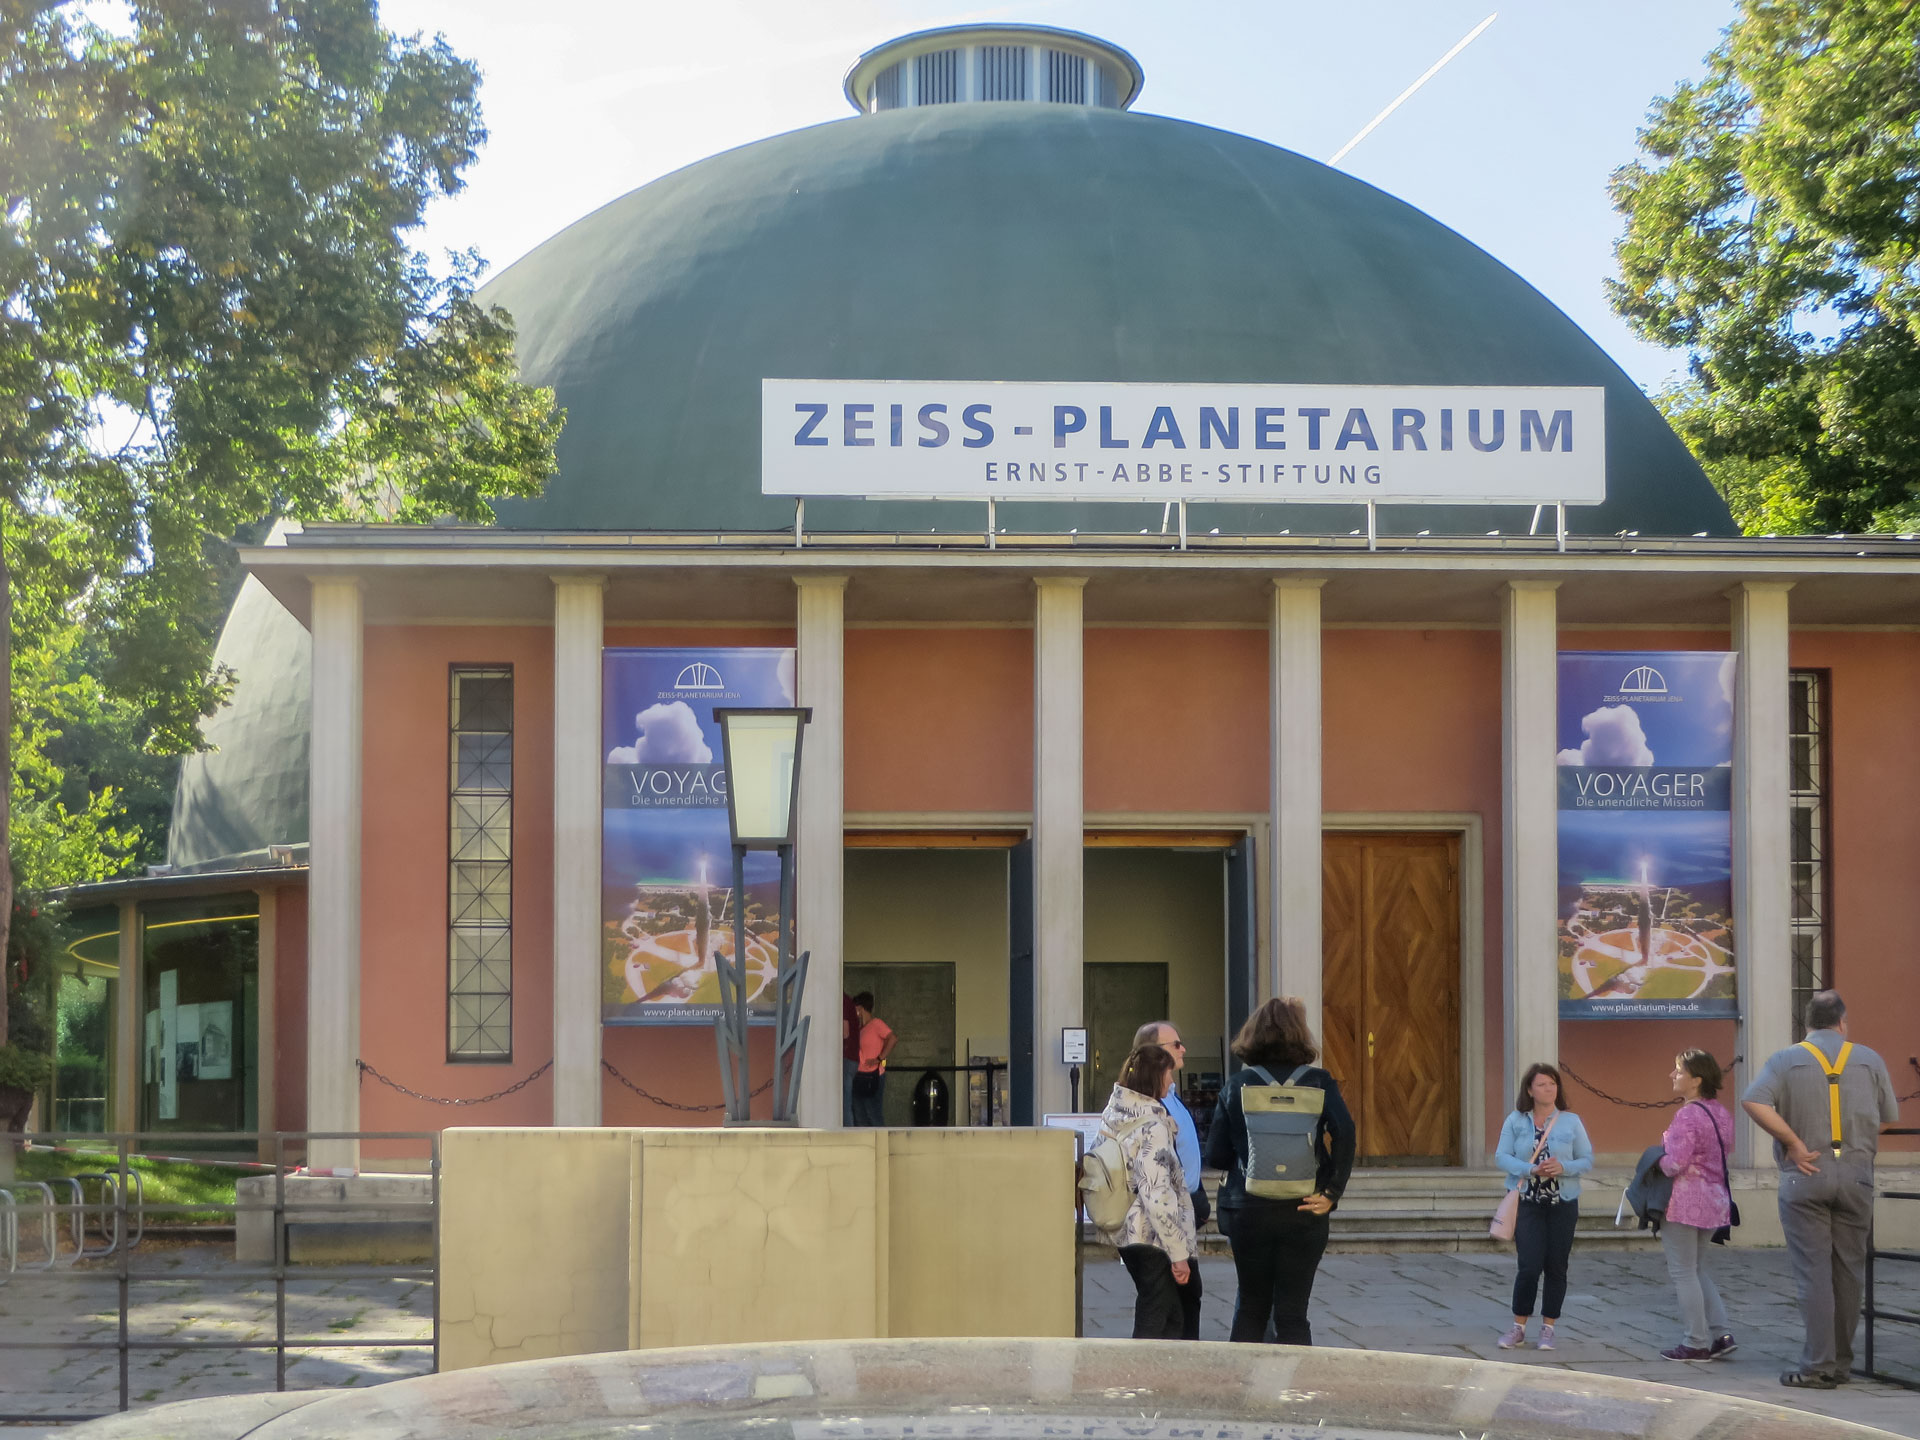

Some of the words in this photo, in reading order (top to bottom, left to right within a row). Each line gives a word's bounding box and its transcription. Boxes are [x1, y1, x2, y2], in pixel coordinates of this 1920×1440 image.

[794, 402, 1574, 453] ZEISS-PLANETARIUM
[985, 462, 1382, 485] ERNST-ABBE-STIFTUNG
[657, 691, 724, 699] ZEISS-PLANETARIUM
[1602, 695, 1666, 703] ZEISS-PLANETARIUM
[631, 770, 727, 794] VOYAG
[1575, 772, 1705, 796] VOYAGER
[631, 795, 651, 806] Die
[654, 794, 719, 806] unendliche
[1576, 797, 1594, 807] Die
[1597, 796, 1659, 807] unendliche
[1662, 797, 1704, 807] Mission
[1591, 1002, 1699, 1013] www.planetarium-jena.de
